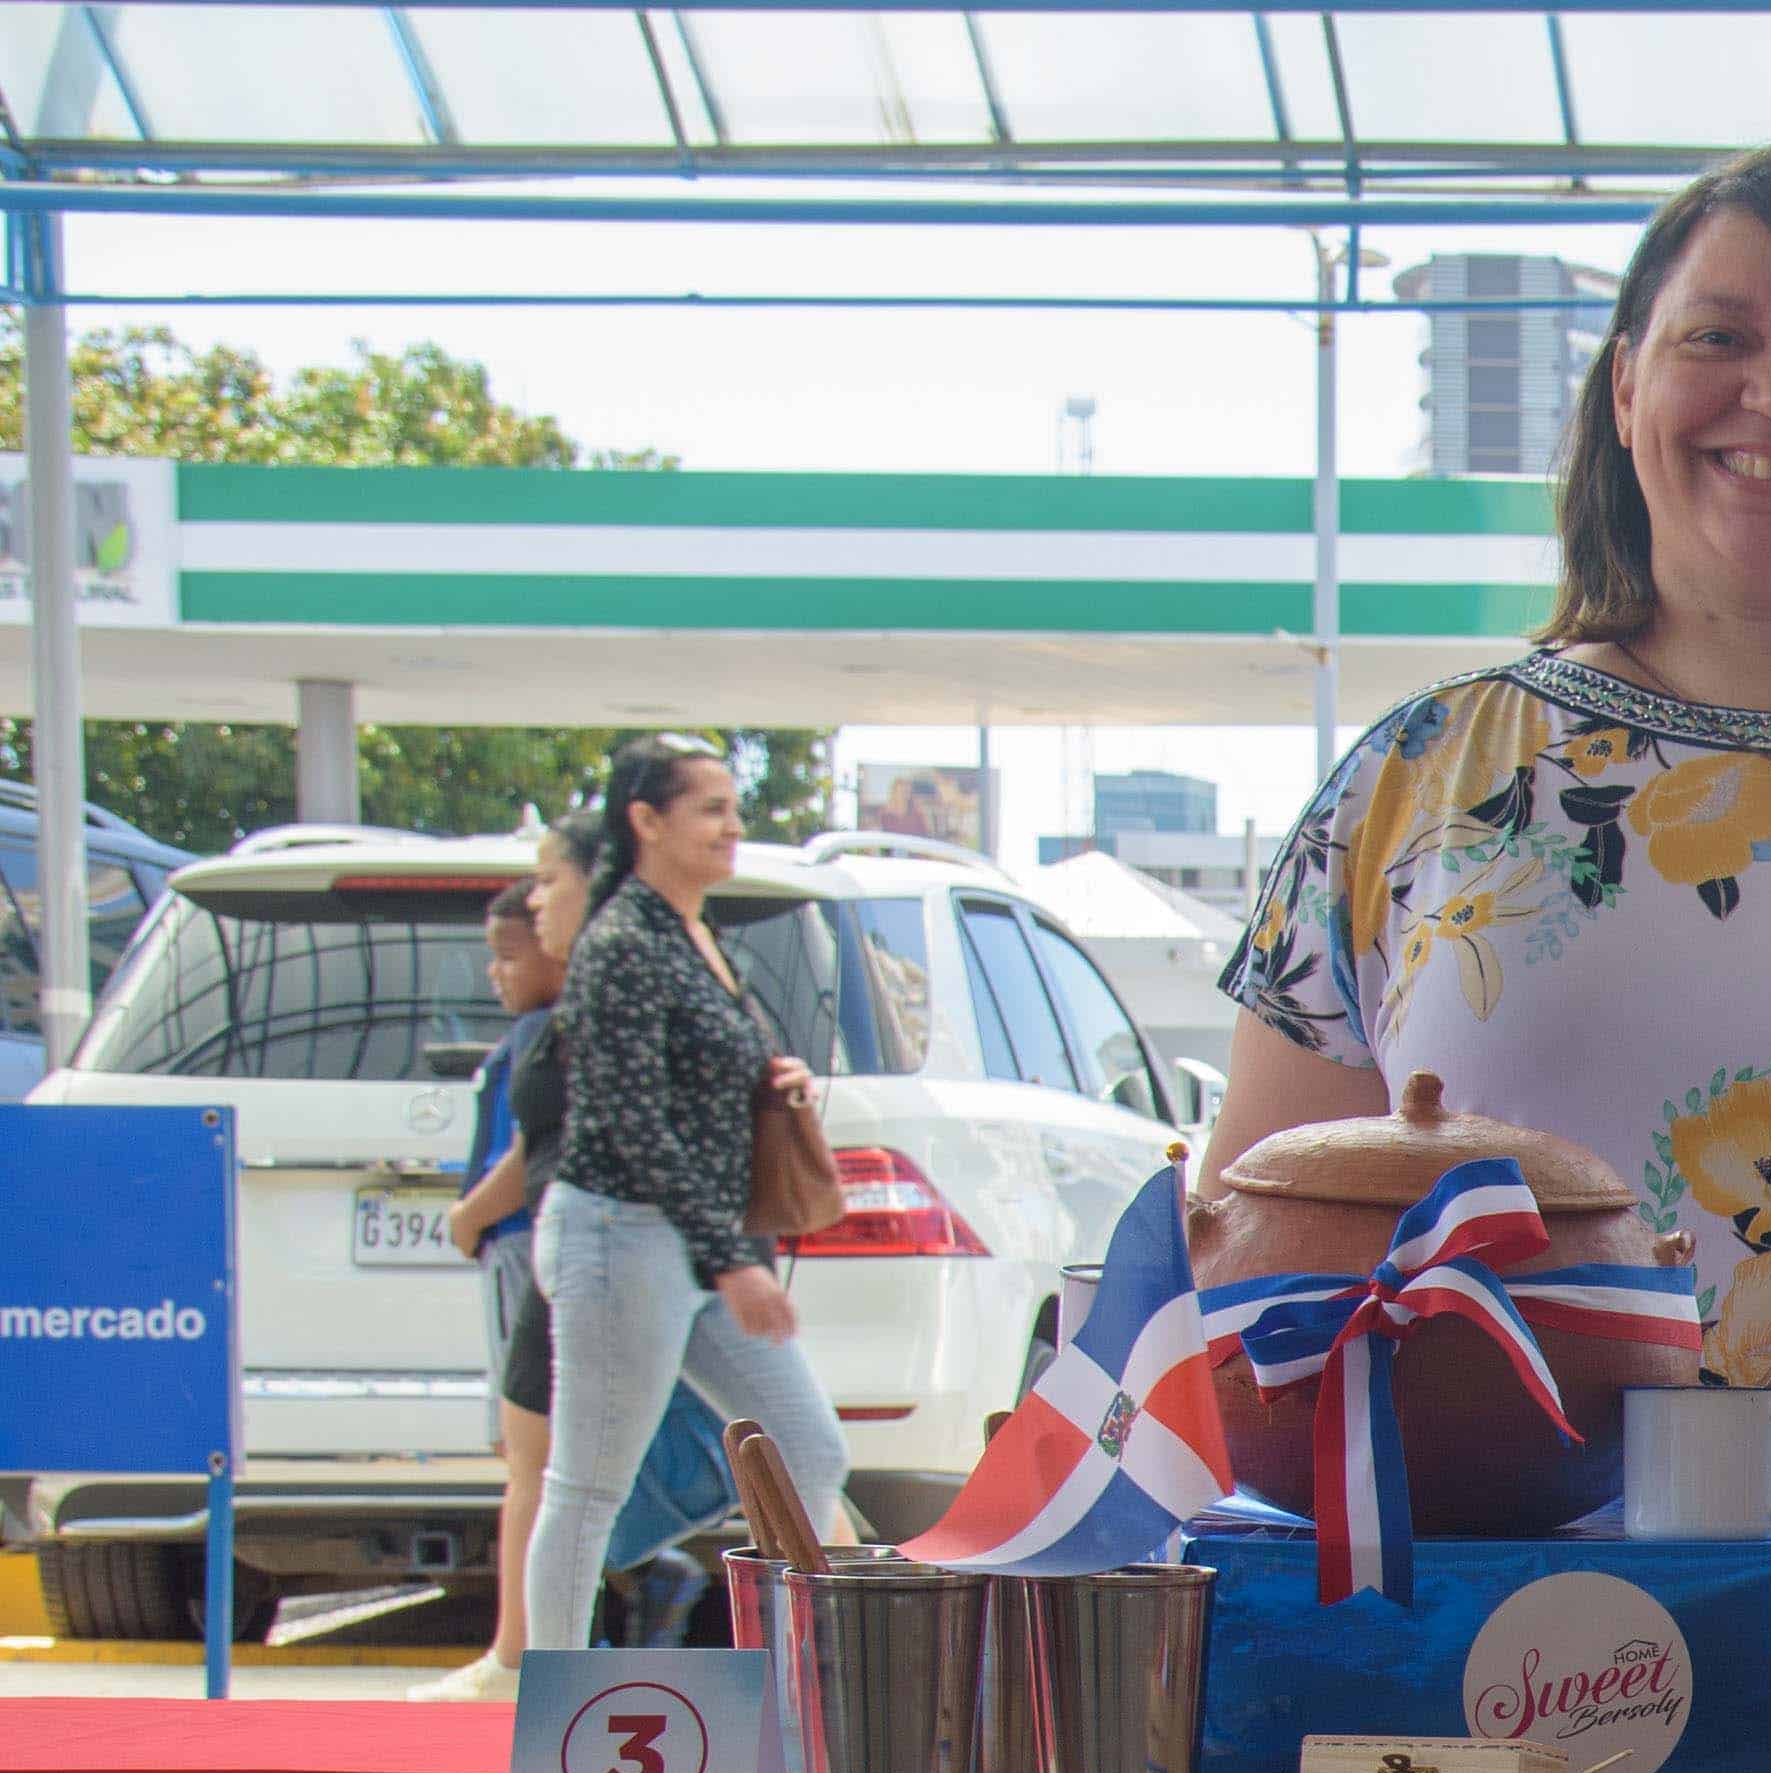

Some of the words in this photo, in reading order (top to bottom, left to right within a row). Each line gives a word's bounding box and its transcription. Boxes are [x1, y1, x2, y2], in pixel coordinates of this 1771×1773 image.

[363, 1211, 456, 1247] G394
[0, 1299, 206, 1339] mercado
[1613, 1646, 1661, 1665] HOME
[1475, 1639, 1681, 1740] Sweet
[1556, 1687, 1685, 1740] Bersoly
